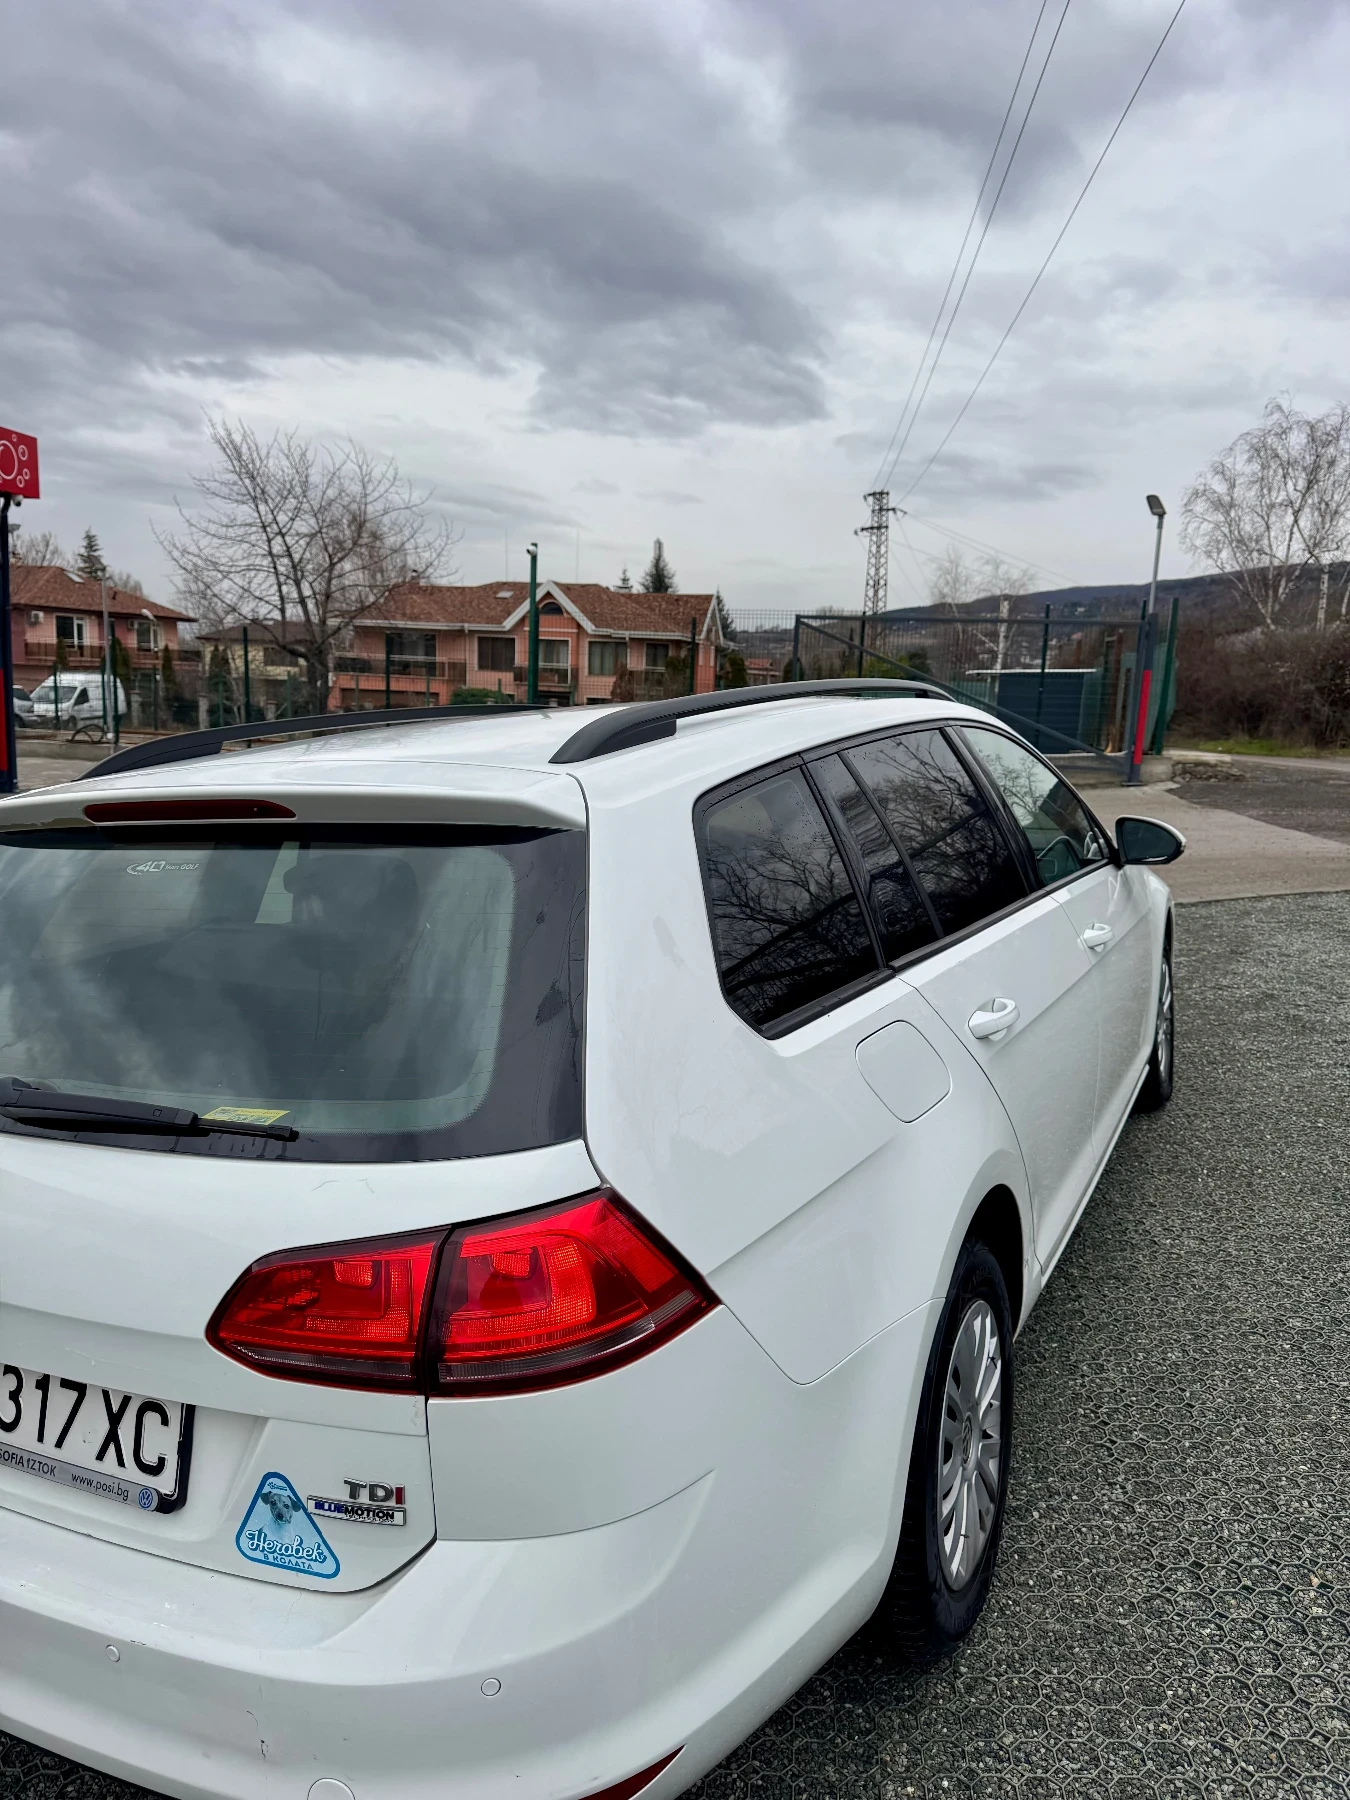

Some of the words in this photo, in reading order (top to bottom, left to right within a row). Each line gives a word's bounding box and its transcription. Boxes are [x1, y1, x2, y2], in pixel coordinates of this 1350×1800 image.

[136, 861, 166, 871] 40
[95, 1389, 170, 1477] XC
[71, 1473, 129, 1501] www.posi.bg
[343, 1477, 405, 1505] TDI
[314, 1501, 394, 1519] BLUEMOTION
[273, 1555, 314, 1570] КОЛАТА
